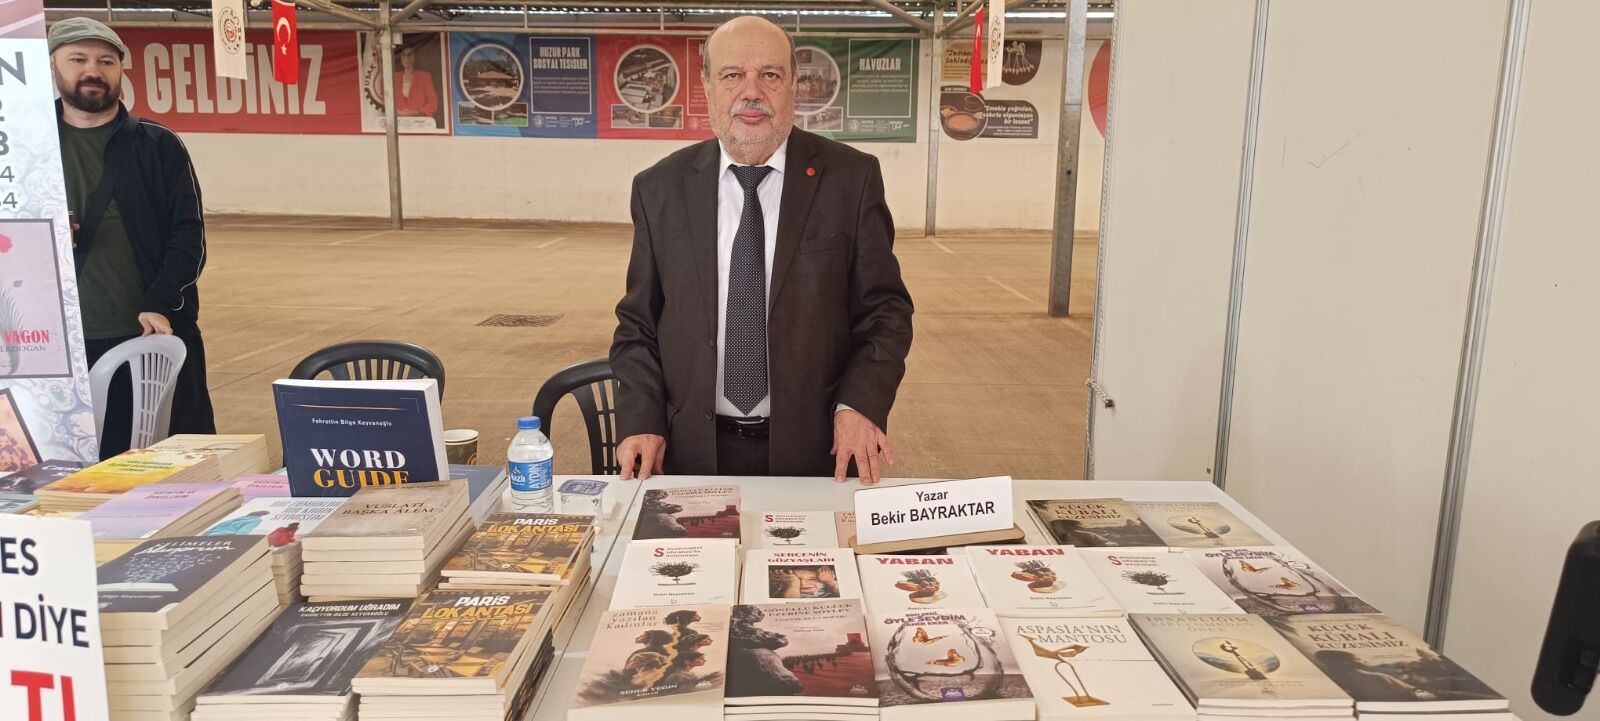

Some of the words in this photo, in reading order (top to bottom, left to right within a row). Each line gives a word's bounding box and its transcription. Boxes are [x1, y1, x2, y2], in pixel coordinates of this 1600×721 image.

[310, 448, 406, 468] WORD
[313, 469, 409, 488] GUIDE
[916, 491, 948, 502] Yazar
[871, 510, 906, 526] Bekir
[910, 501, 995, 522] BAYRAKTAR
[513, 518, 559, 526] PARİS
[487, 524, 579, 534] LOKANTASI
[985, 548, 1065, 556] YABAN
[876, 557, 954, 565] YABAN
[455, 595, 511, 607] PARİS
[298, 605, 359, 613] KAÇIYORDUM
[421, 603, 534, 619] LOKANTASI
[14, 593, 91, 649] DİYE
[1017, 622, 1122, 635] ASPASİA'NIN
[1306, 623, 1374, 633] KÜÇÜK
[1038, 633, 1128, 644] MANTOSU
[1308, 631, 1396, 642] KÜBALI
